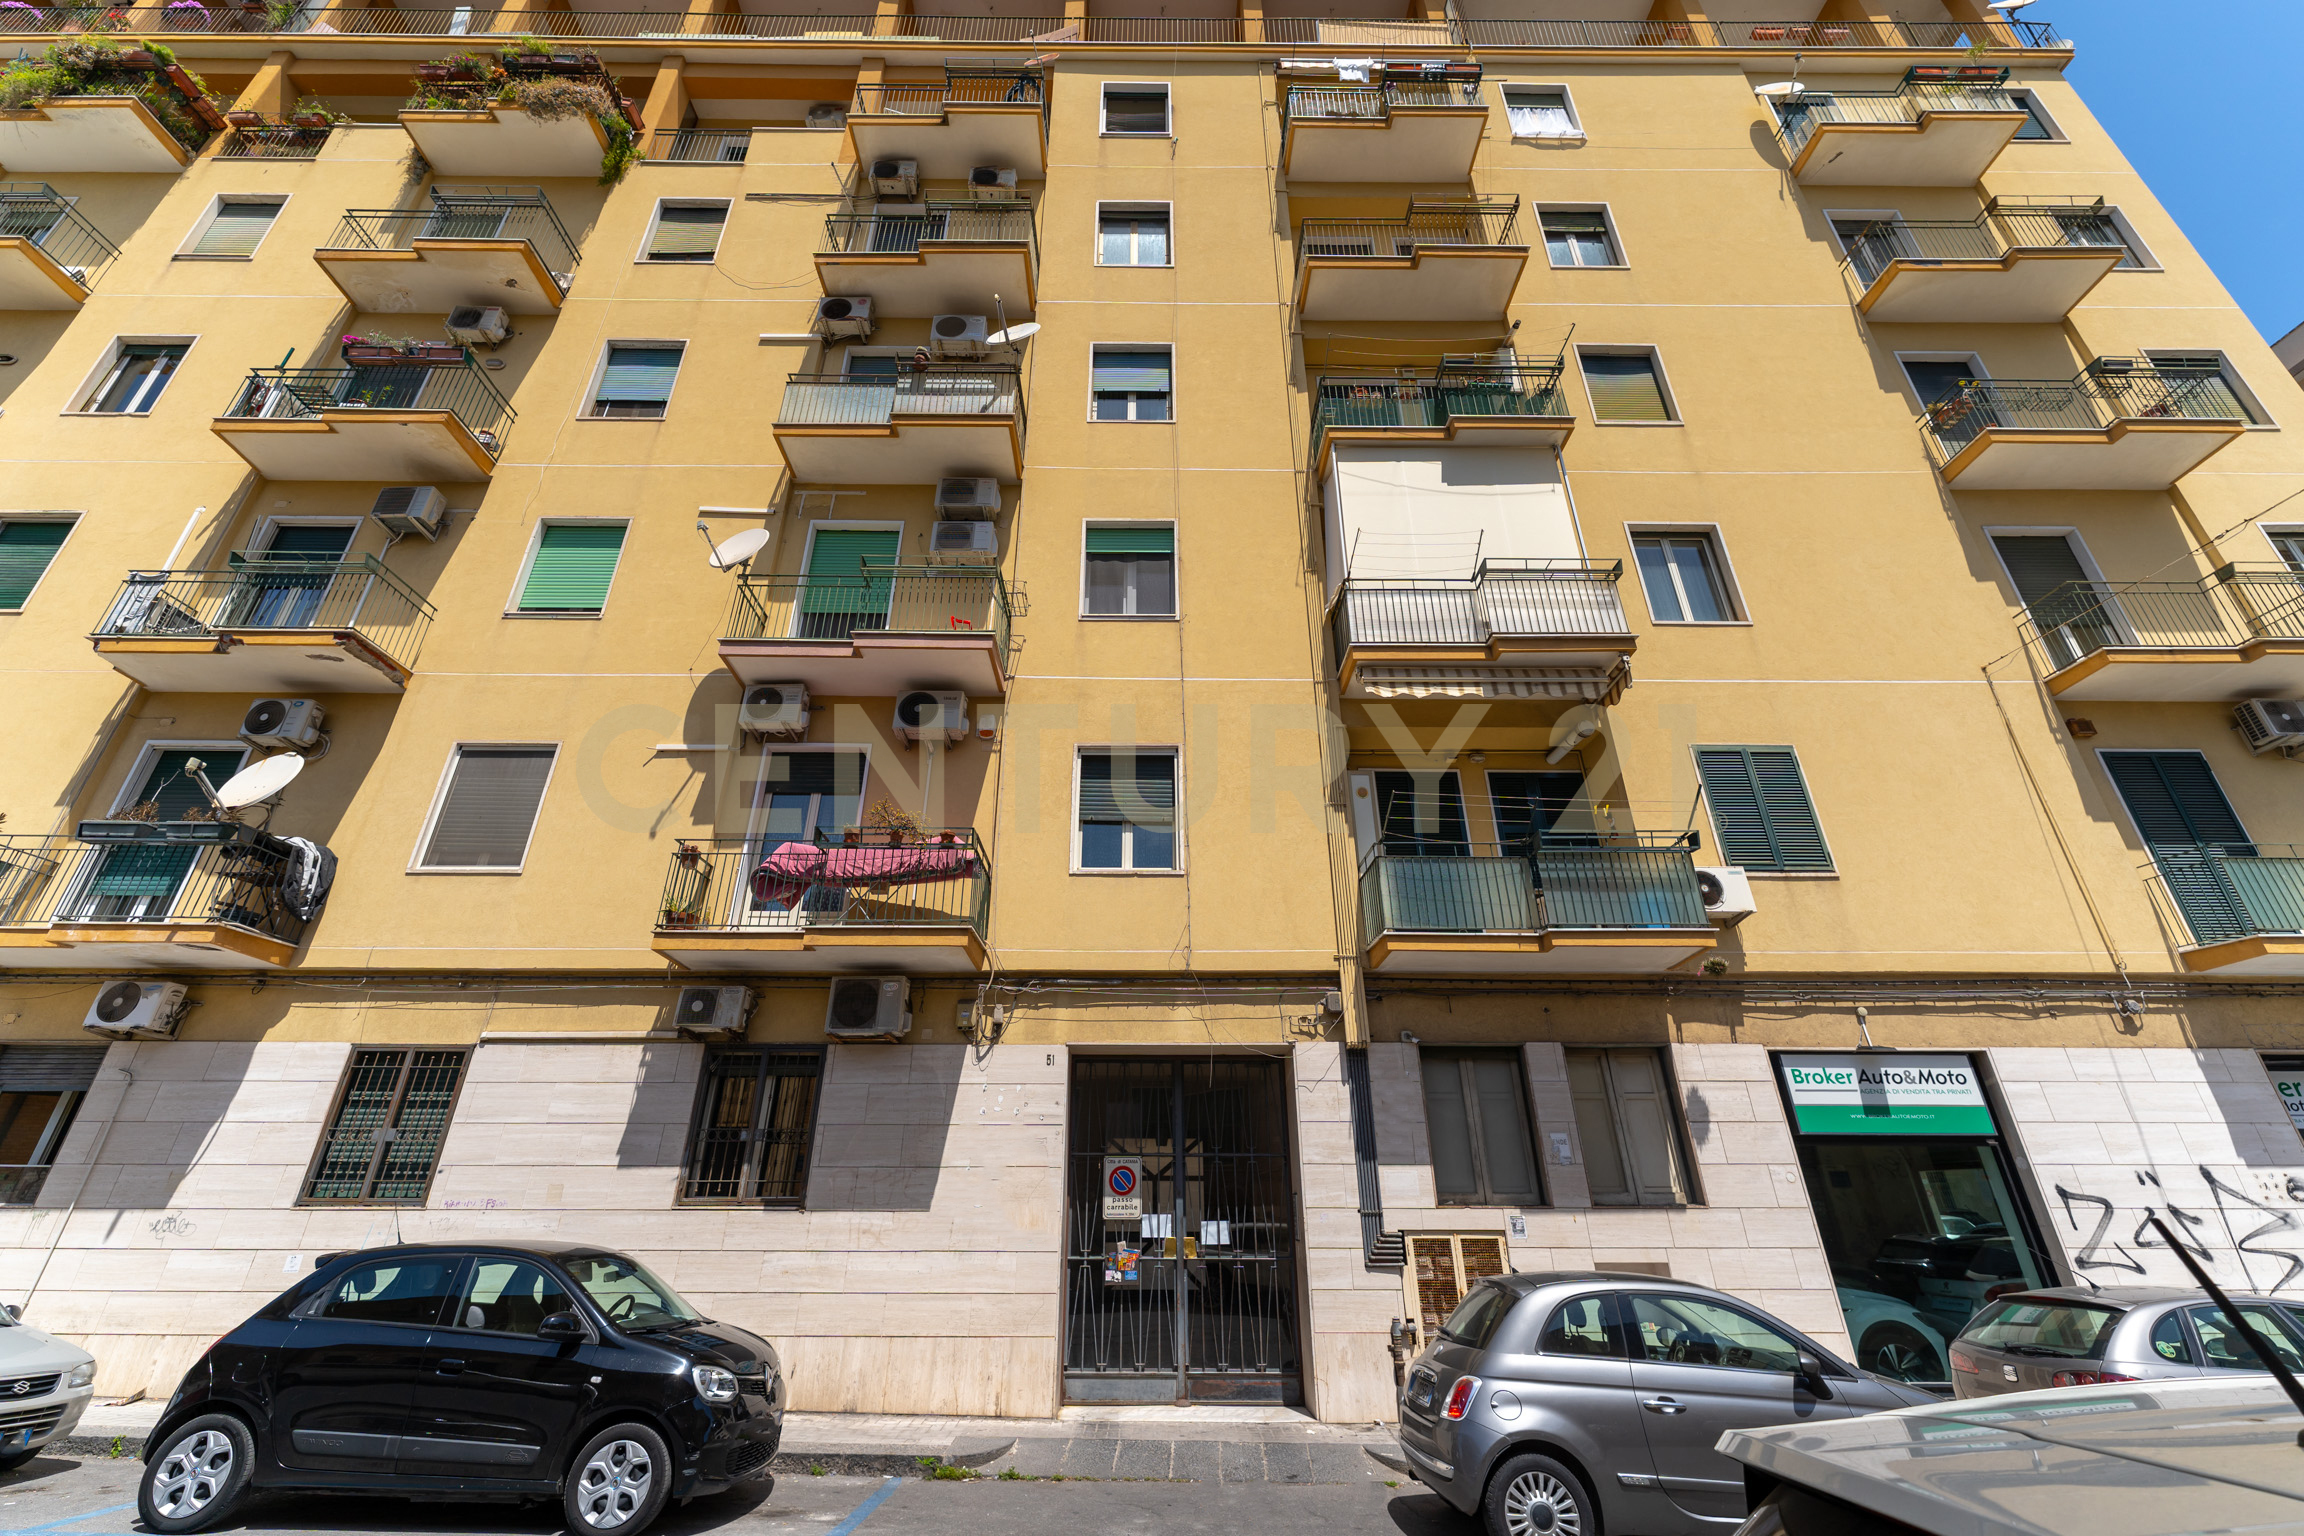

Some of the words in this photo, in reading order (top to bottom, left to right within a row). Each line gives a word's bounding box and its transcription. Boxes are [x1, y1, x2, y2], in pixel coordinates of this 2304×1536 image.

[1046, 1053, 1055, 1066] 51
[1790, 1067, 1853, 1085] Broker
[1858, 1068, 1968, 1085] Auto&Moto
